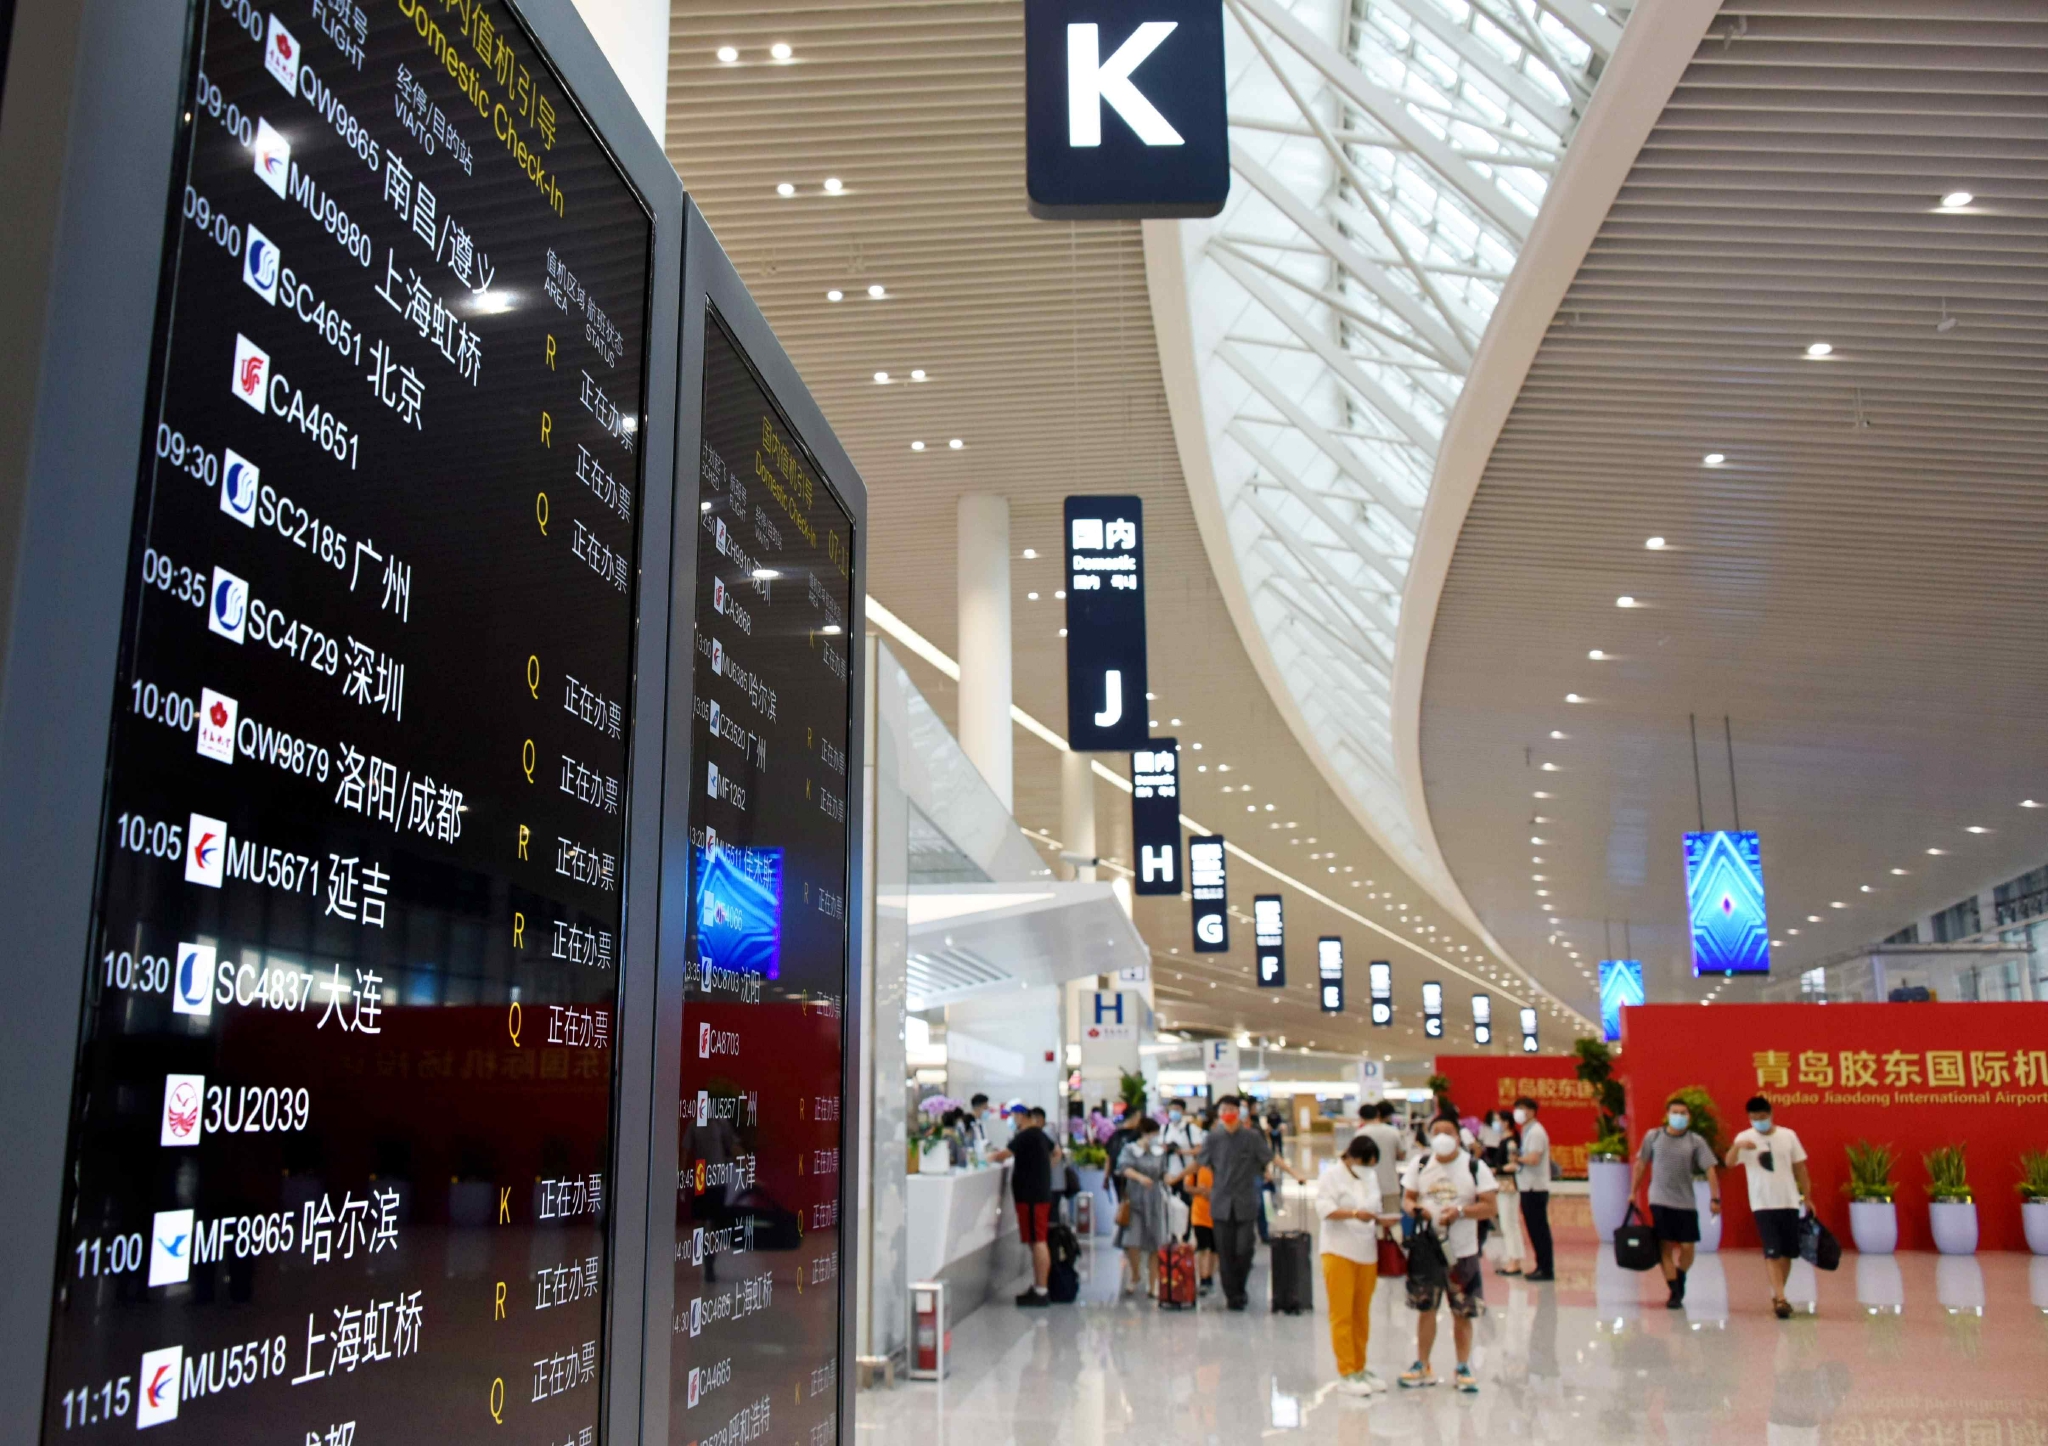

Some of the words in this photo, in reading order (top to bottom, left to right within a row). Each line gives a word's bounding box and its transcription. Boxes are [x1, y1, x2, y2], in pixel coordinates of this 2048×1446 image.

[1067, 21, 1185, 147] K
[493, 103, 565, 219] Check-In
[396, 62, 474, 177] 经停/目的站
[546, 246, 586, 312] 值机区域
[586, 296, 624, 357] 航班状态
[299, 65, 380, 171] QW9865
[384, 148, 495, 297] 南昌/遵义
[546, 333, 557, 372] R
[579, 368, 634, 455] 正在办票
[196, 70, 252, 148] 09:00
[289, 160, 371, 268] MU9980
[374, 247, 482, 387] 上海虹桥
[540, 410, 552, 449] R
[575, 442, 631, 524] 正在办票
[544, 275, 568, 315] AREA
[585, 323, 615, 369] STATUS
[184, 184, 241, 257] 09:00
[279, 267, 362, 366] SC4651
[367, 338, 427, 431] 北京
[536, 492, 549, 536] Q
[571, 518, 629, 594] 正在办票
[269, 373, 359, 471] CA4651
[755, 450, 789, 511] Domestic
[702, 509, 716, 537] 2:50
[725, 533, 751, 577] ZH9910
[156, 422, 217, 487] 09:30
[258, 484, 347, 571] SC2185
[351, 538, 412, 624] 广州
[527, 655, 540, 700] Q
[563, 673, 622, 741] 正在办票
[724, 592, 752, 636] CA3868
[141, 548, 206, 609] 09:35
[248, 599, 339, 677] SC4729
[341, 635, 405, 723] 深圳
[522, 739, 535, 784] Q
[559, 754, 619, 816] 正在办票
[721, 651, 748, 692] MU6385
[748, 672, 778, 725] 哈尔滨
[806, 727, 813, 750] R
[1094, 669, 1123, 728] J
[719, 713, 747, 750] CZ3520
[746, 729, 767, 774] 广州
[131, 679, 195, 733] 10:00
[237, 716, 329, 783] QW9879
[334, 741, 464, 846] 洛阳/成都
[518, 823, 530, 862] R
[555, 836, 616, 892] 正在办票
[717, 773, 747, 811] MF1262
[1141, 844, 1174, 883] H
[117, 812, 182, 861] 10:05
[226, 839, 319, 897] MU5671
[324, 852, 391, 930] 延吉
[513, 911, 525, 950] R
[551, 919, 613, 970] 正在办票
[1197, 913, 1224, 944] G
[712, 965, 740, 993] SC8703
[740, 965, 761, 1006] 沈阳
[1261, 955, 1279, 981] F
[103, 950, 170, 994] 10:30
[215, 962, 313, 1014] SC4837
[316, 963, 384, 1036] 大连
[508, 1001, 522, 1048] Q
[547, 1005, 609, 1049] 正在办票
[1094, 992, 1123, 1025] H
[1323, 986, 1340, 1008] E
[1371, 1003, 1390, 1023] D
[709, 1028, 740, 1056] CA8703
[1214, 1041, 1228, 1061] F
[1426, 1018, 1441, 1036] C
[1475, 1026, 1490, 1043] B
[1523, 1036, 1538, 1052] A
[1364, 1061, 1378, 1077] D
[1752, 1049, 2048, 1088] 青岛胶东国际机
[203, 1086, 310, 1133] 3U2039
[679, 1098, 697, 1119] 13:40
[707, 1097, 736, 1120] MU5257
[736, 1089, 758, 1128] 广州
[1823, 1091, 1891, 1107] Jiaodong
[1894, 1090, 1991, 1104] International
[1994, 1091, 2048, 1107] Airport
[734, 1151, 756, 1192] 天津
[75, 1233, 143, 1279] 11:00
[193, 1210, 295, 1265] MF8965
[301, 1185, 401, 1266] 哈尔滨
[499, 1186, 511, 1225] K
[539, 1173, 603, 1220] 正在办票
[703, 1226, 733, 1256] SC8707
[733, 1214, 755, 1255] 兰州
[701, 1292, 731, 1326] SC4665
[731, 1270, 773, 1321] 上海虹桥
[62, 1375, 131, 1431] 11:15
[181, 1335, 287, 1401] MU5518
[290, 1290, 424, 1388] 上海虹桥
[495, 1281, 507, 1321] R
[535, 1256, 599, 1310] 正在办票
[489, 1377, 504, 1425] Q
[531, 1340, 596, 1403] 正在办票
[699, 1357, 732, 1396] CA4665
